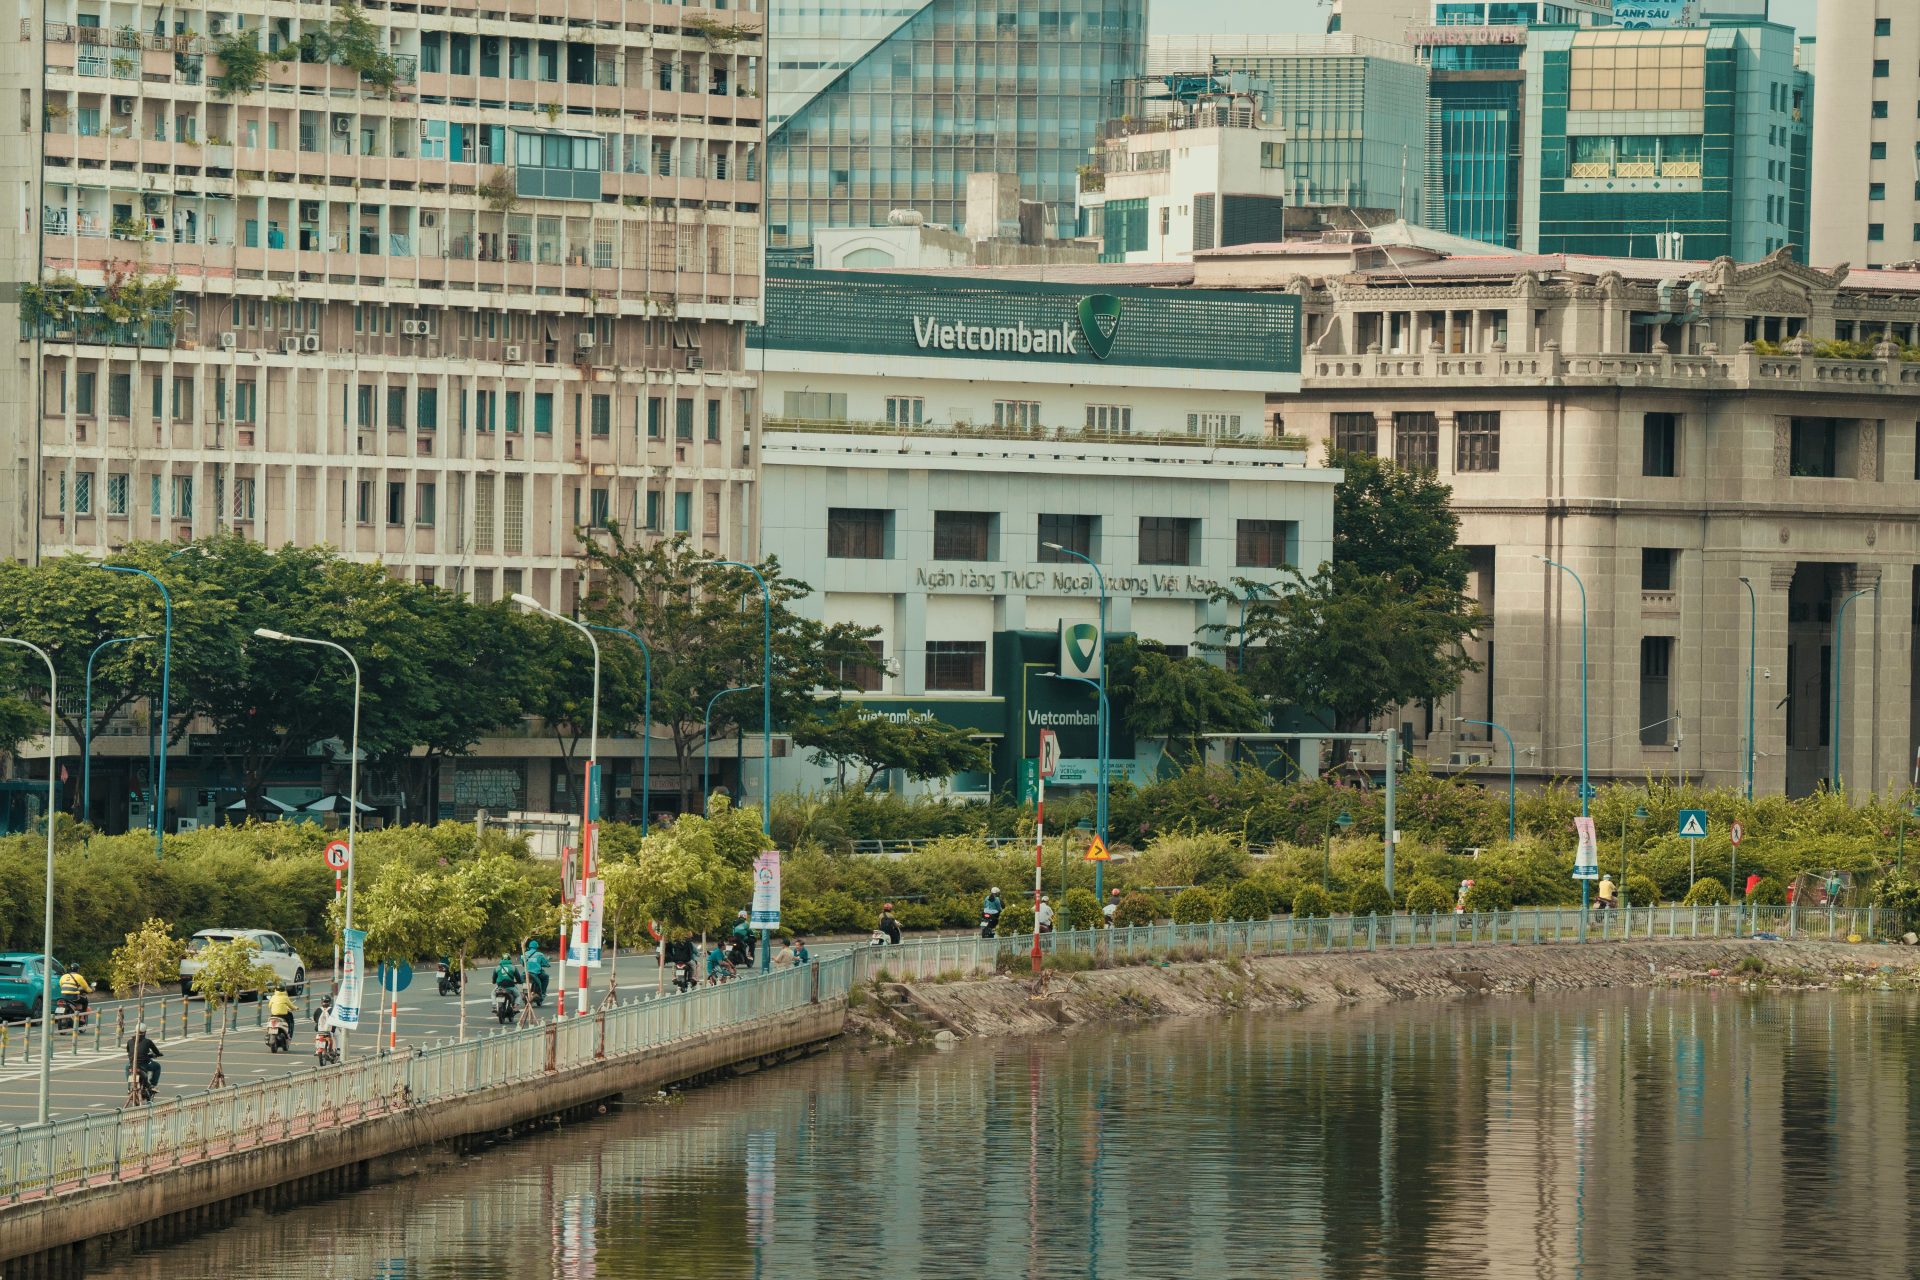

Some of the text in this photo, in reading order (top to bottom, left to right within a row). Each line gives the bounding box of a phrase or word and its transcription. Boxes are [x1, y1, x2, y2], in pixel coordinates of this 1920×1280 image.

[1615, 8, 1670, 19] LẠNH SÂU
[913, 315, 1077, 354] Vietcombank
[1000, 570, 1046, 589] TMCP
